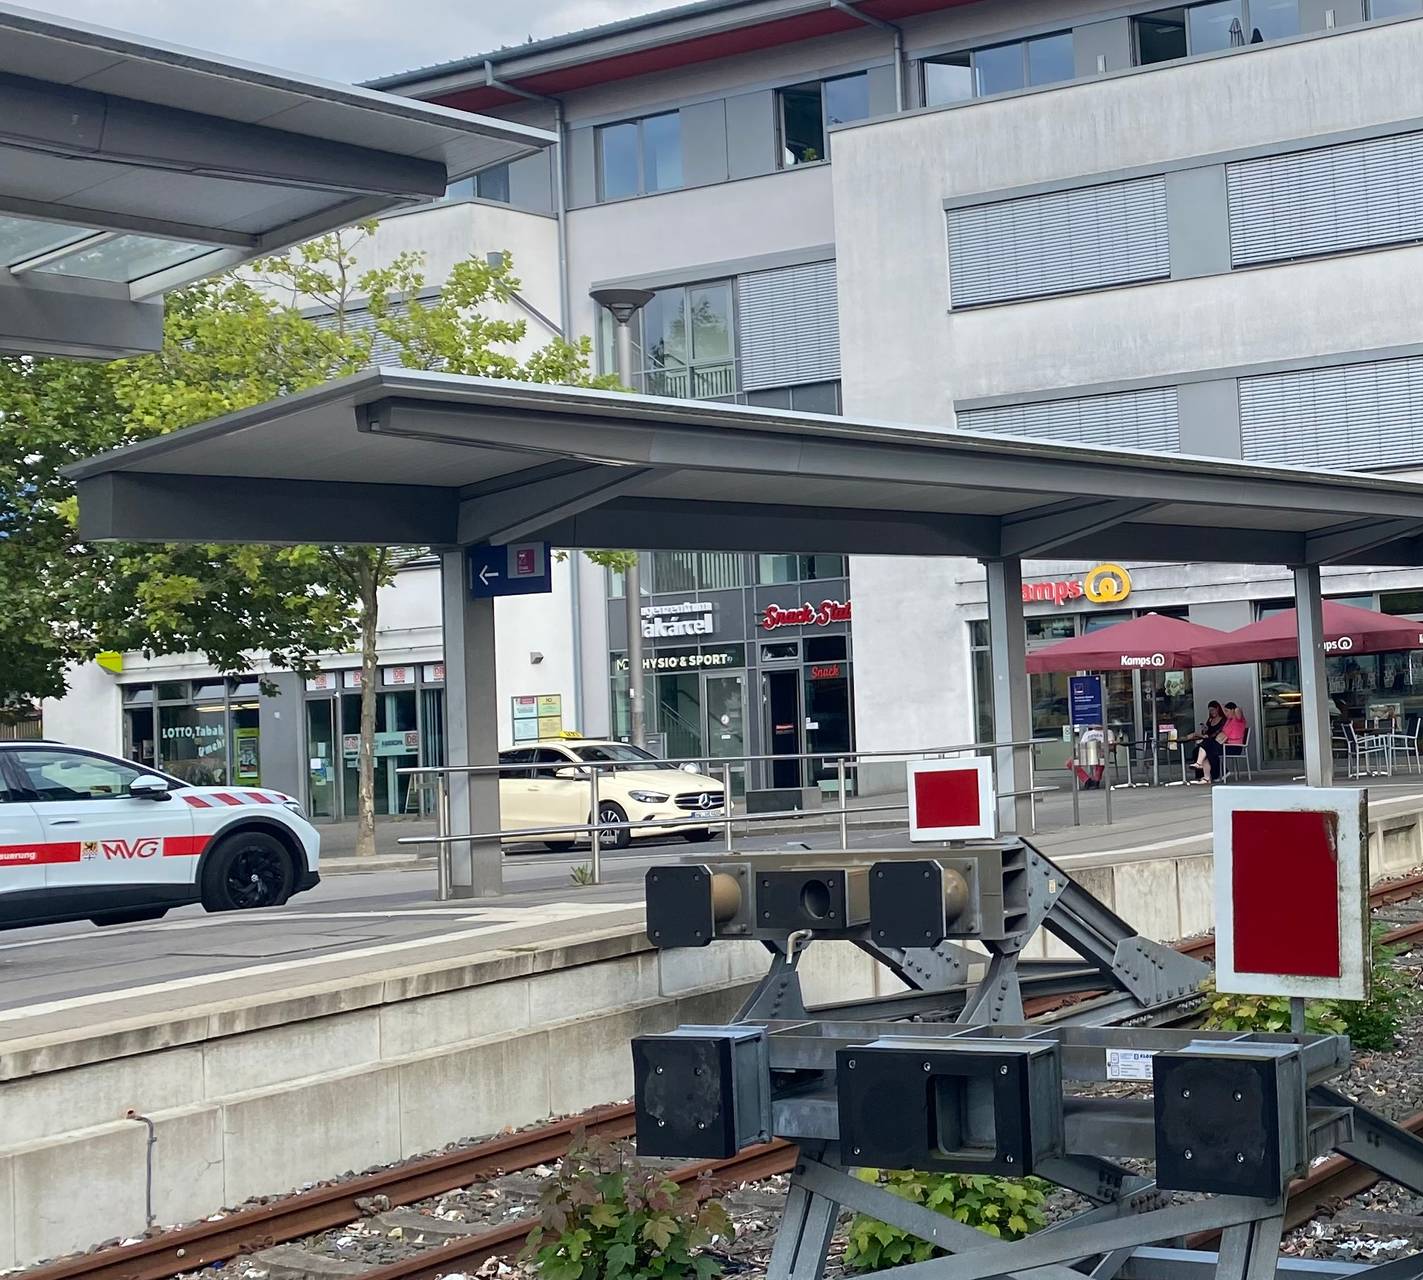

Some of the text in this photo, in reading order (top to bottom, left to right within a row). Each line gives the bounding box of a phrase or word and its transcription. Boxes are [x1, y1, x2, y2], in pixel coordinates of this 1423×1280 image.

[1022, 579, 1082, 605] amps
[763, 602, 816, 631] Snack
[679, 656, 688, 667] &
[688, 654, 728, 667] SPORT
[1120, 654, 1151, 667] Kamps
[811, 663, 839, 679] Snack
[100, 837, 161, 860] MVG
